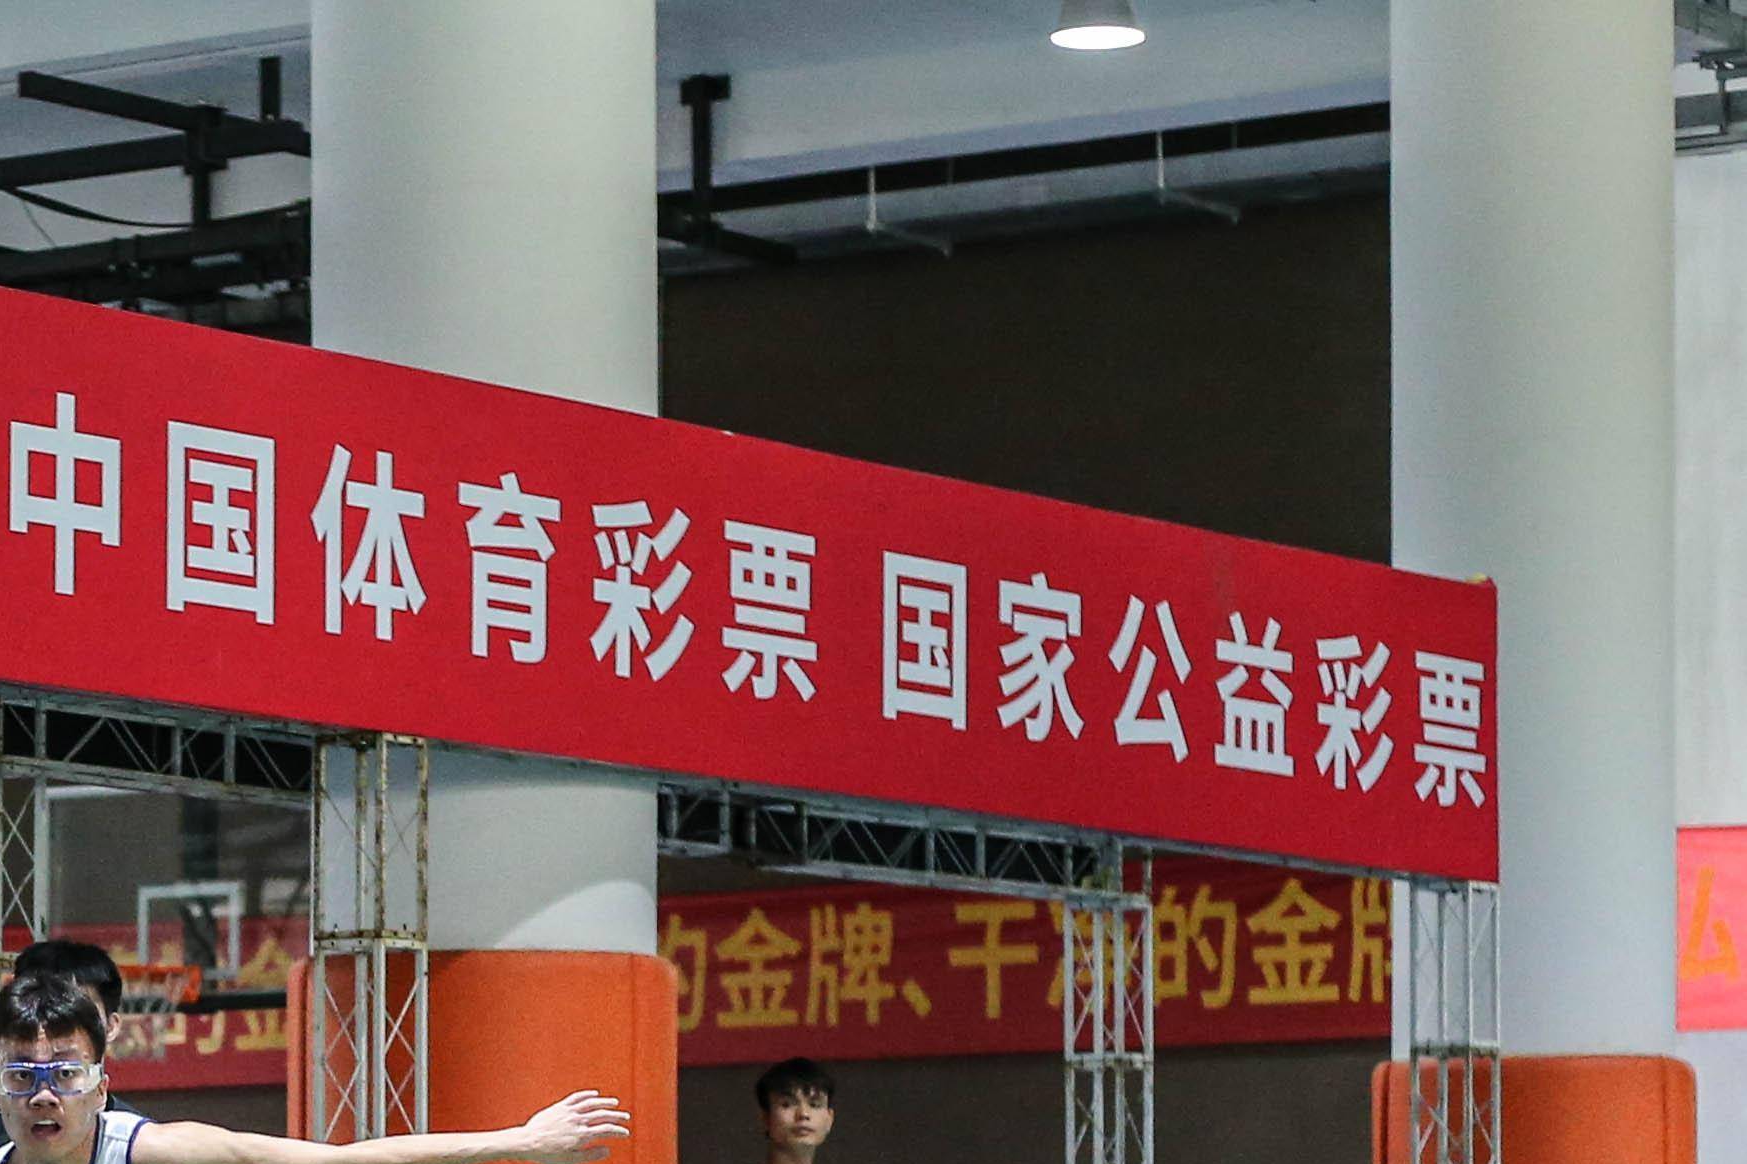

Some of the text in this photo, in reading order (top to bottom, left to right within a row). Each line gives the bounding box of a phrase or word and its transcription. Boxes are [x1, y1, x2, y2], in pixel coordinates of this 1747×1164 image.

[10, 392, 1486, 806] 中国体育彩票 国家公益彩票
